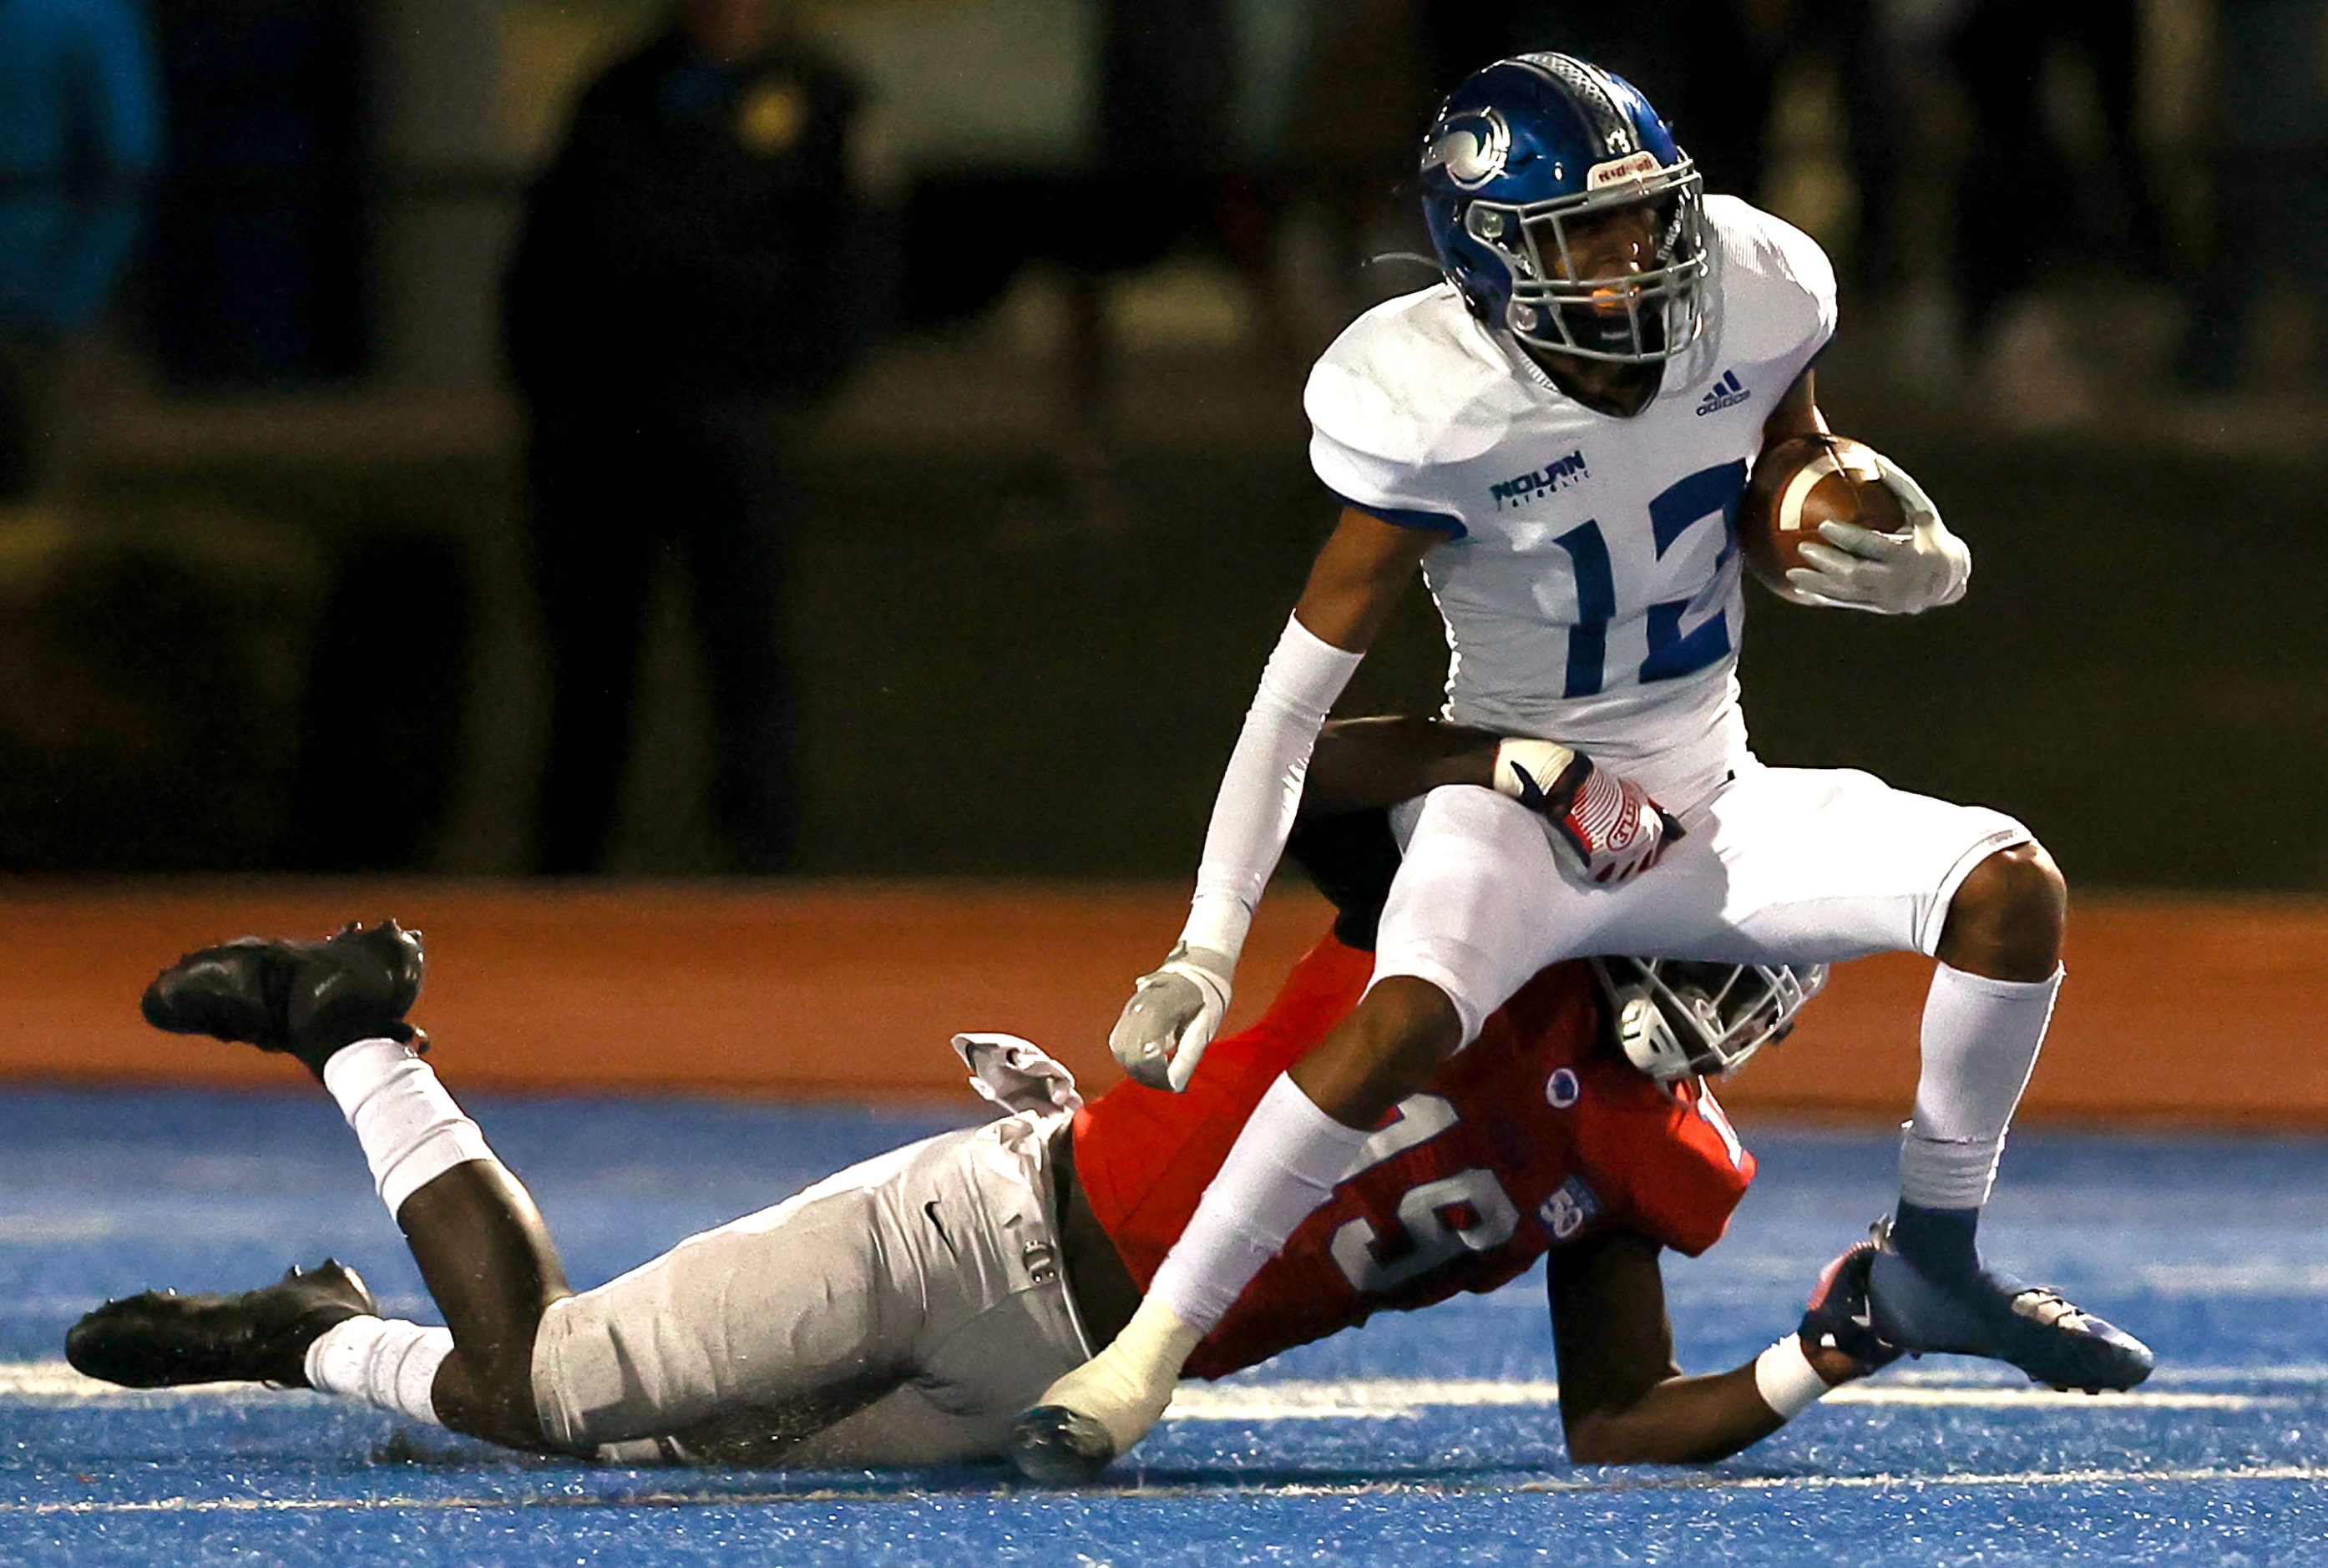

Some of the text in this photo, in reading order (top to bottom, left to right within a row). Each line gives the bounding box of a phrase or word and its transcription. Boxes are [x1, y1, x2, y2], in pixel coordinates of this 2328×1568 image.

[1696, 390, 1750, 416] adidas
[1490, 450, 1586, 503] NOLAN
[1552, 457, 1749, 699] 12
[1329, 1093, 1521, 1292] 19
